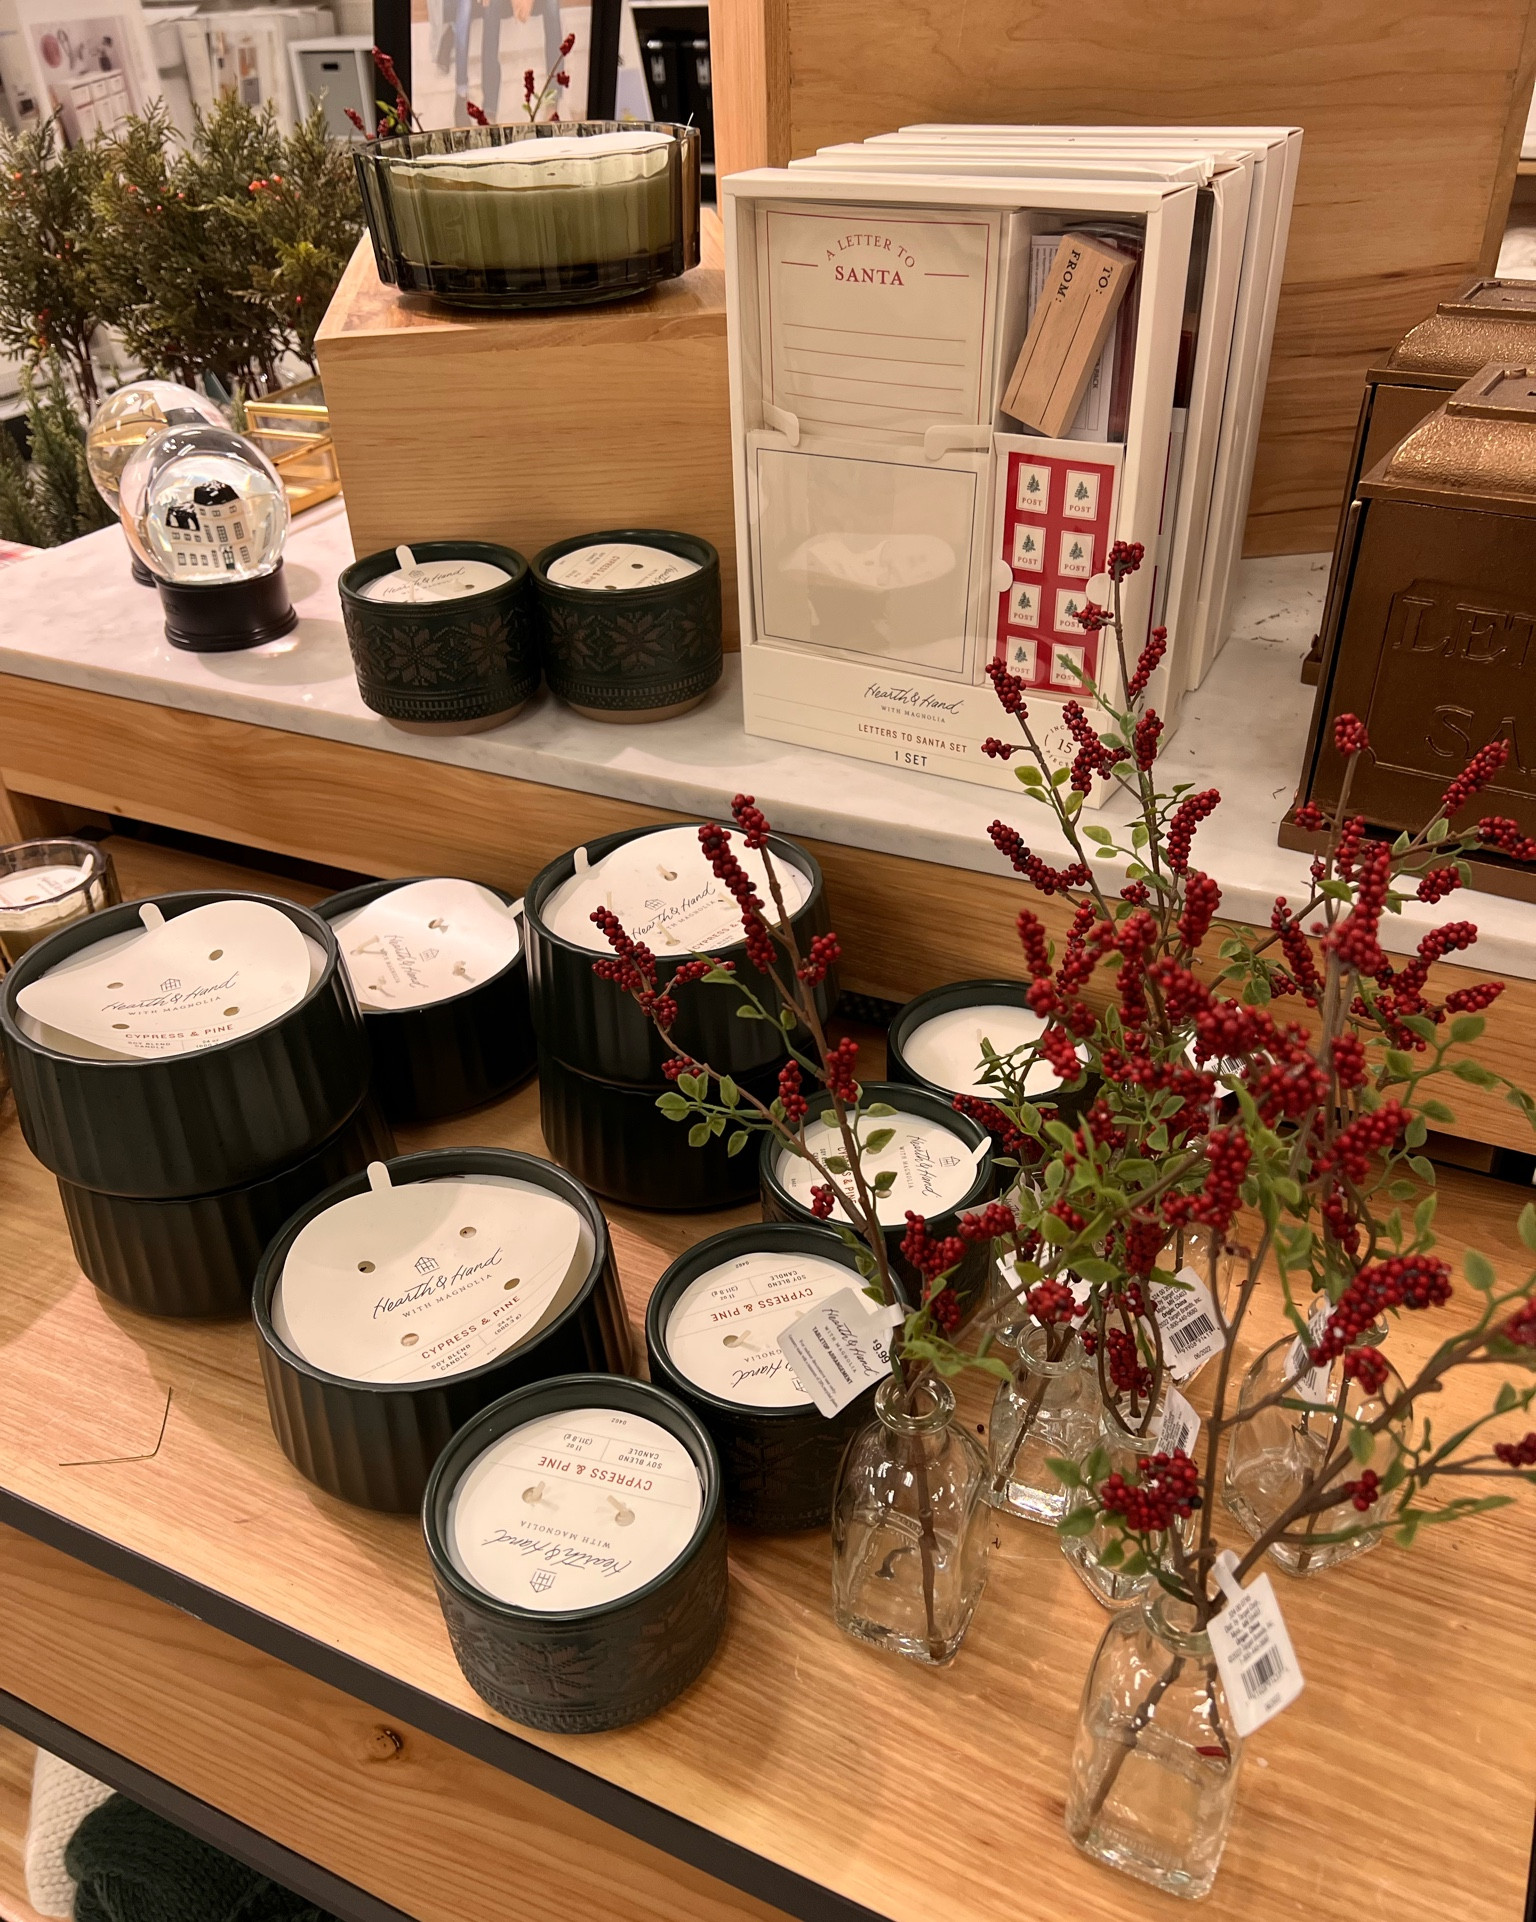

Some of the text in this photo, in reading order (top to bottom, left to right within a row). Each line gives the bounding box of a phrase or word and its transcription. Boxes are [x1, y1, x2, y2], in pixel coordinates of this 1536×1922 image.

[825, 233, 916, 269] A LETTER TO
[834, 265, 905, 287] SANTA
[1054, 249, 1082, 304] FROM:
[1094, 265, 1114, 296] TO:
[1021, 496, 1043, 507] POST
[1068, 504, 1092, 514] POST
[1017, 555, 1039, 566] POST
[1063, 563, 1087, 573] POST
[1012, 612, 1034, 622] POST
[1009, 665, 1031, 675] POST
[863, 682, 964, 715] Hearth & Hand
[880, 705, 946, 724] WITH MAGNOLIA
[858, 723, 968, 754] LETTERS TO SANTA SET
[1057, 738, 1074, 754] 15
[895, 751, 928, 767] 1 SET
[681, 881, 717, 911] Hand
[678, 900, 716, 924] MAGNOLIA
[691, 928, 730, 950] CYPRESS
[101, 970, 240, 1013] Hearth & Hand
[128, 995, 222, 1017] WITH MAGNOLIA
[124, 1023, 234, 1040] CYPRESS & PINE
[906, 1135, 933, 1165] Hearth
[903, 1161, 913, 1188] MAGNOLIA
[919, 1169, 942, 1198] Hand
[373, 1247, 503, 1319] Hearth & Hand
[767, 1274, 807, 1289] SOY BLEND
[770, 1270, 798, 1281] CANDLE
[402, 1274, 493, 1319] WITH MAGNOLIA
[710, 1287, 814, 1323] CYPRESS & PINE
[1175, 1299, 1187, 1309] China
[421, 1325, 477, 1359] CYPRESS
[481, 1317, 491, 1326] &
[492, 1295, 521, 1317] PINE
[1168, 1312, 1182, 1322] Target
[822, 1308, 854, 1344] Hearth
[851, 1345, 879, 1377] Hand
[825, 1326, 857, 1374] WITH MAGNOLIA
[872, 1339, 891, 1364] $9.99
[431, 1358, 446, 1370] SOY
[447, 1344, 471, 1360] BLEND
[440, 1352, 469, 1372] CANDLE
[744, 1348, 782, 1363] GNOLIA
[812, 1327, 832, 1353] TABLETOP
[827, 1349, 853, 1385] ARRANGEMENT
[731, 1359, 784, 1389] Hand
[610, 1417, 627, 1426] 0462
[618, 1455, 663, 1470] SOY BLEND
[628, 1447, 660, 1460] CANDLE
[537, 1456, 653, 1491] CYPRESS & PINE
[520, 1520, 611, 1549] WITH MAGNOLIA
[481, 1528, 633, 1578] Hearth & Hand
